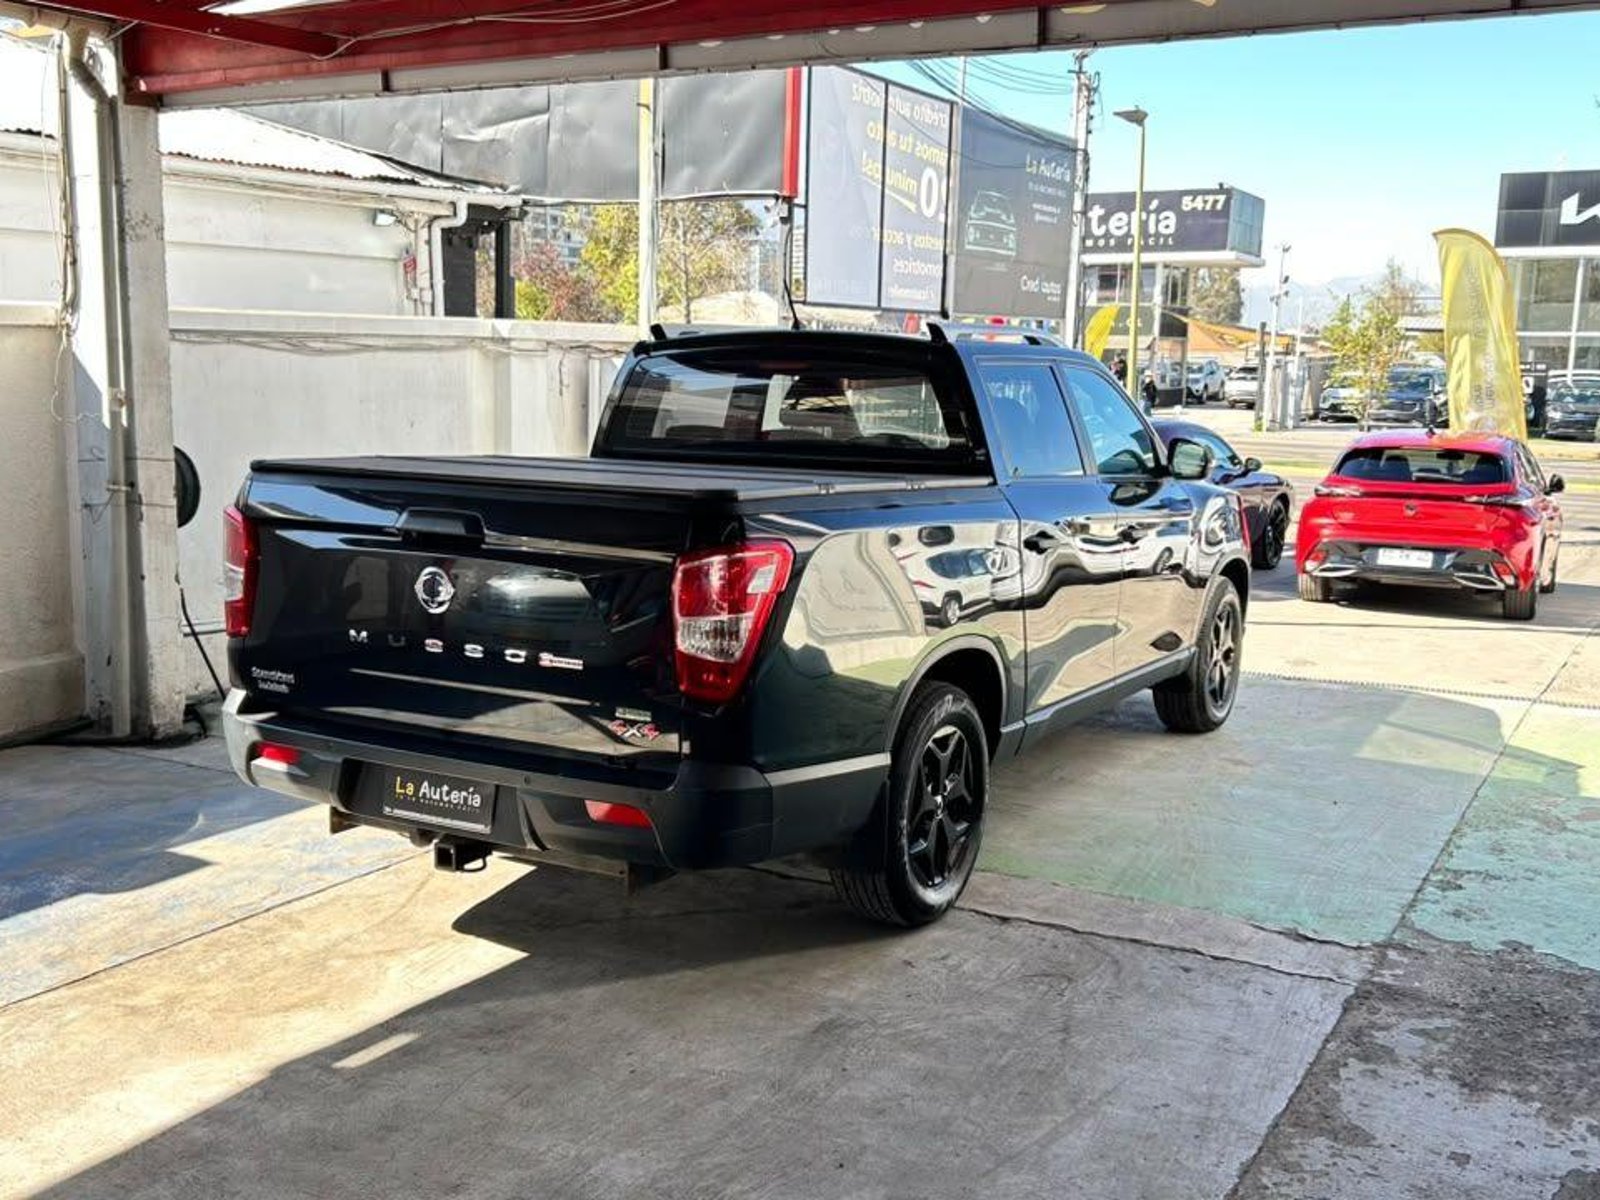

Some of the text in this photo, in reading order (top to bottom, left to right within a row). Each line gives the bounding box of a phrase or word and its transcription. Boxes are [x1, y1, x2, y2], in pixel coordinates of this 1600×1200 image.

[1181, 194, 1227, 212] 5477
[349, 629, 527, 664] MUSSO
[394, 775, 415, 796] La
[418, 780, 482, 808] Autería
